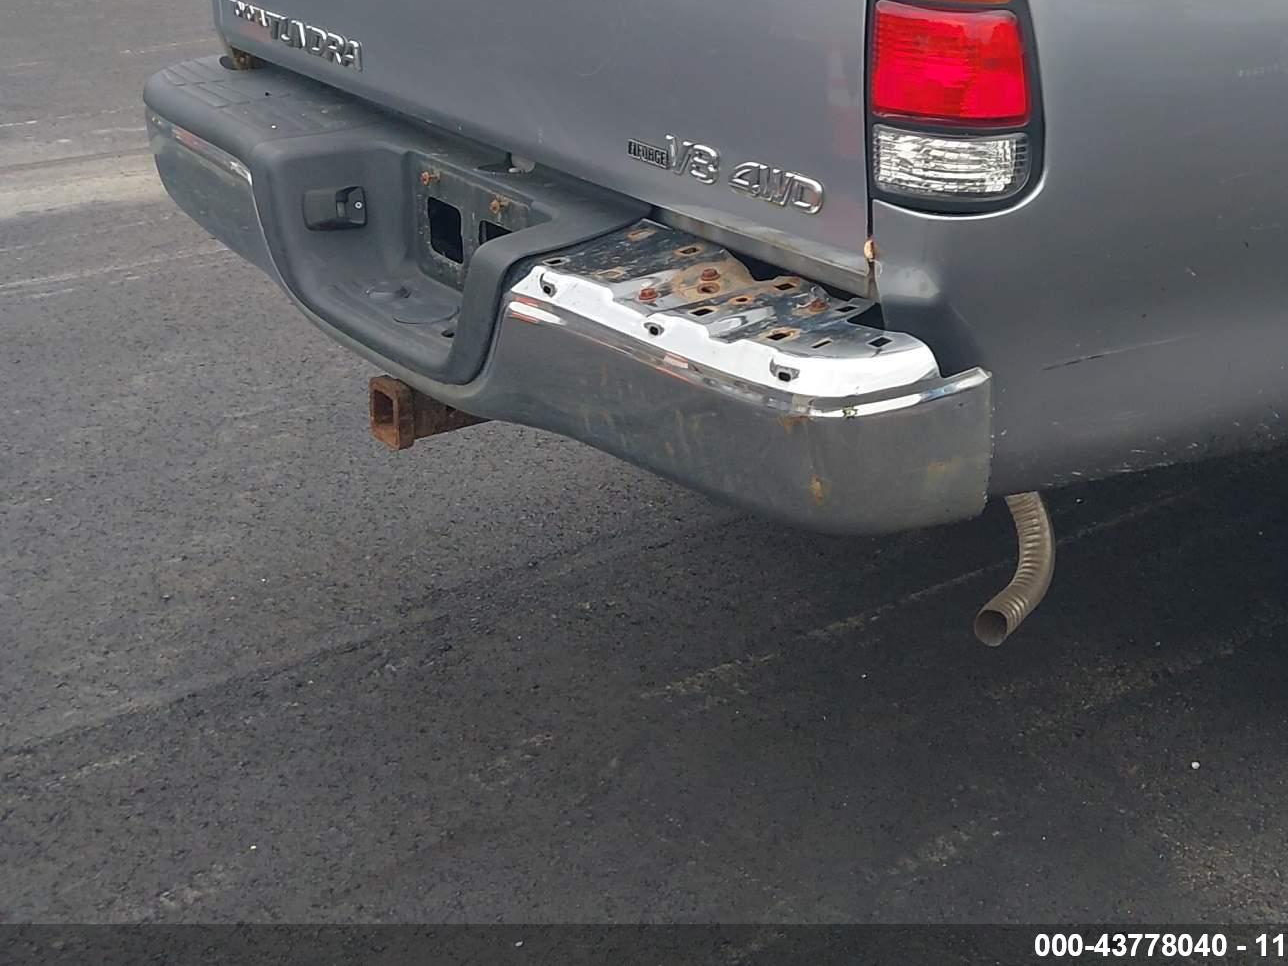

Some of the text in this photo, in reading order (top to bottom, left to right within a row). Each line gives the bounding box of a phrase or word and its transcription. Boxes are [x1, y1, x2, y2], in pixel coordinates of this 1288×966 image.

[265, 10, 363, 73] TUNDRA
[664, 133, 721, 185] V8
[727, 160, 825, 216] 4WD
